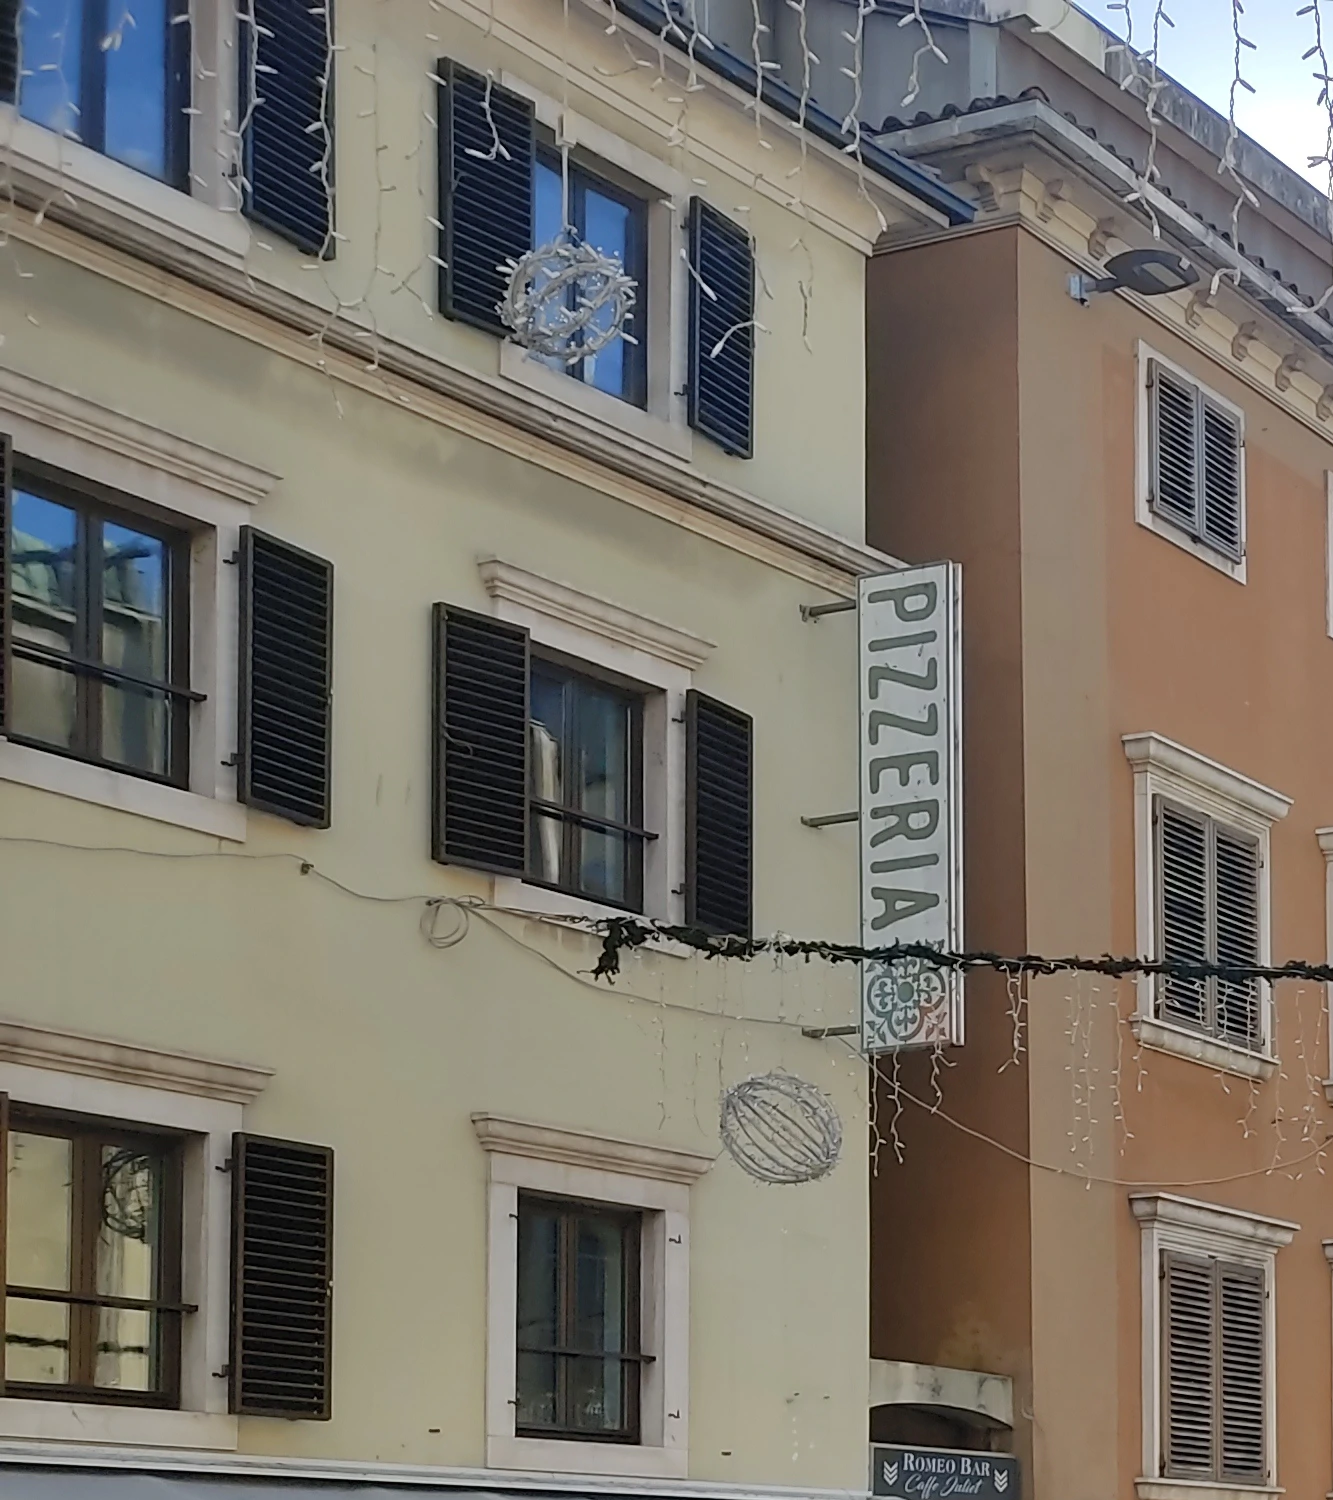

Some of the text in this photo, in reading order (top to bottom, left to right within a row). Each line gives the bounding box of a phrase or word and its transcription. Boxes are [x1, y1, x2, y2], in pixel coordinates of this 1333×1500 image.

[866, 581, 940, 931] PIZZERIA
[903, 1452, 990, 1477] ROMEO BAR
[904, 1473, 983, 1500] Caffe Juliet
